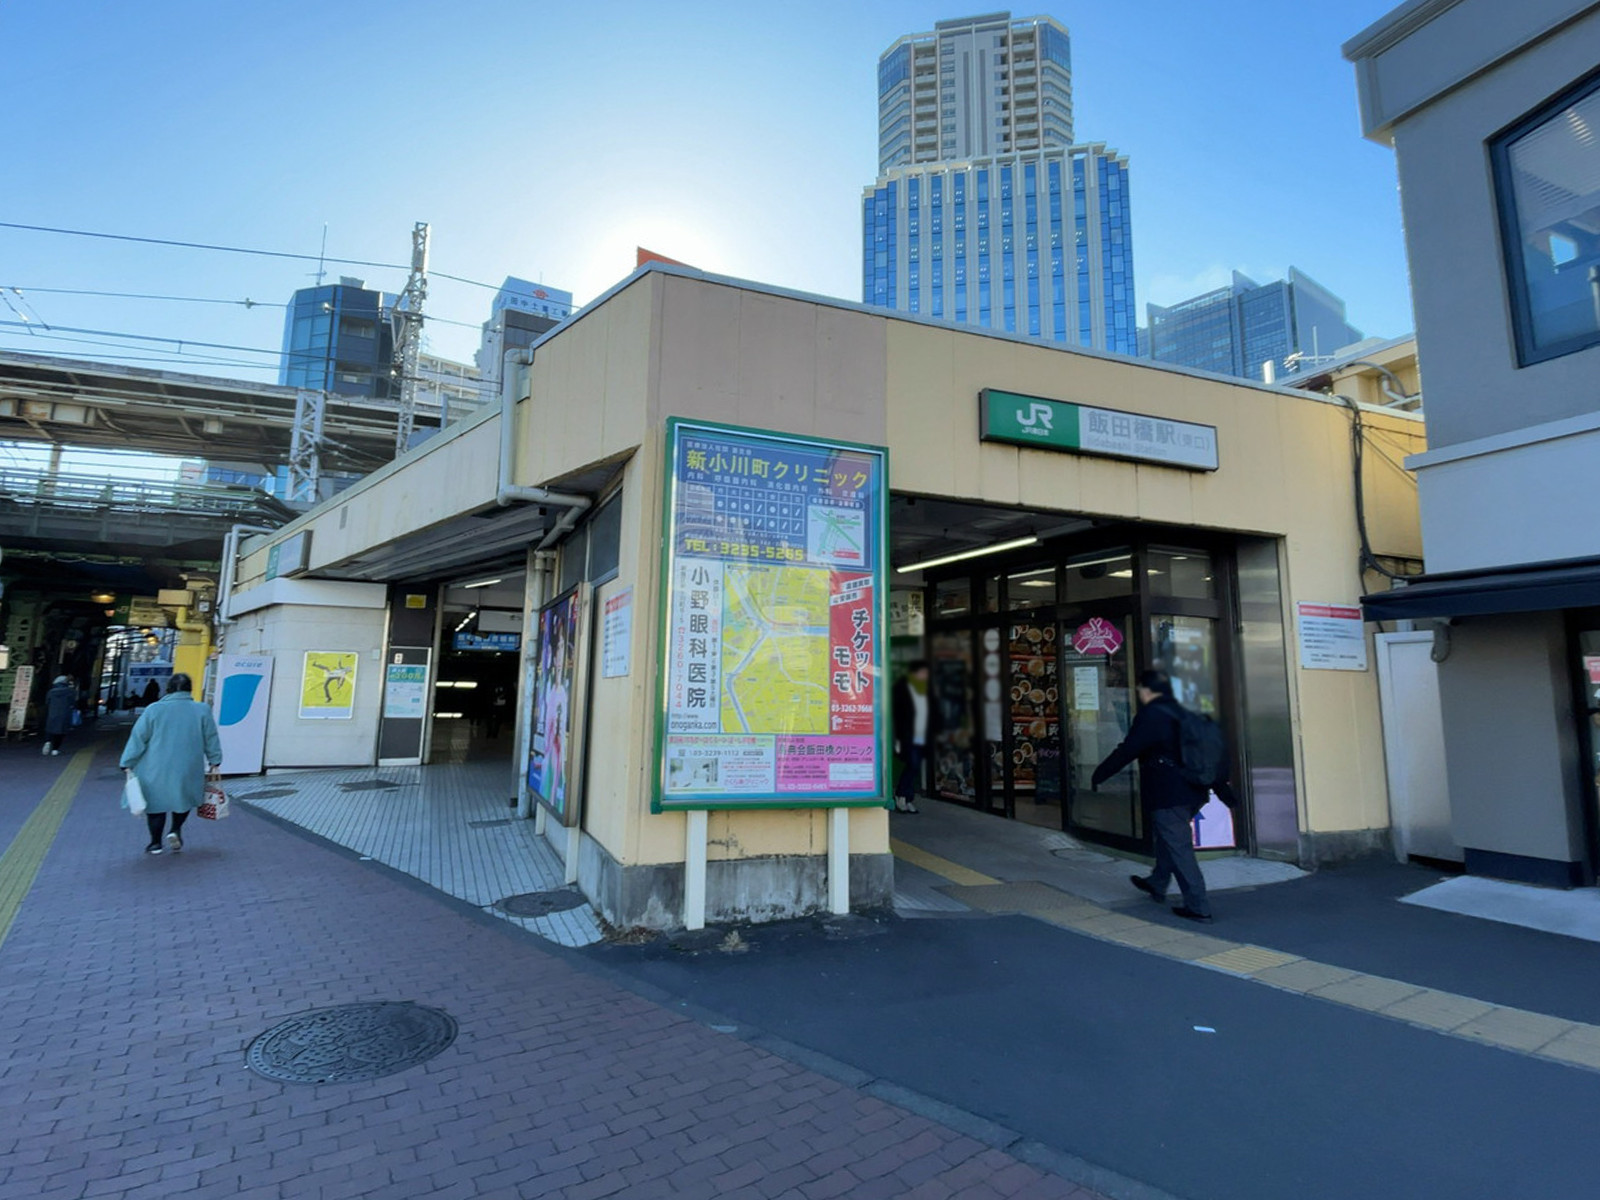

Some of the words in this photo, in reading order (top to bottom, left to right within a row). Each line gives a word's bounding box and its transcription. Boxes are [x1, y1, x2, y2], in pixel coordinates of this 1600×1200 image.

[1016, 403, 1053, 429] JR
[686, 449, 867, 489] 新小川町クリニック
[687, 566, 709, 708] 小野眼科医院
[852, 608, 869, 692] チケット
[835, 647, 850, 691] モモ
